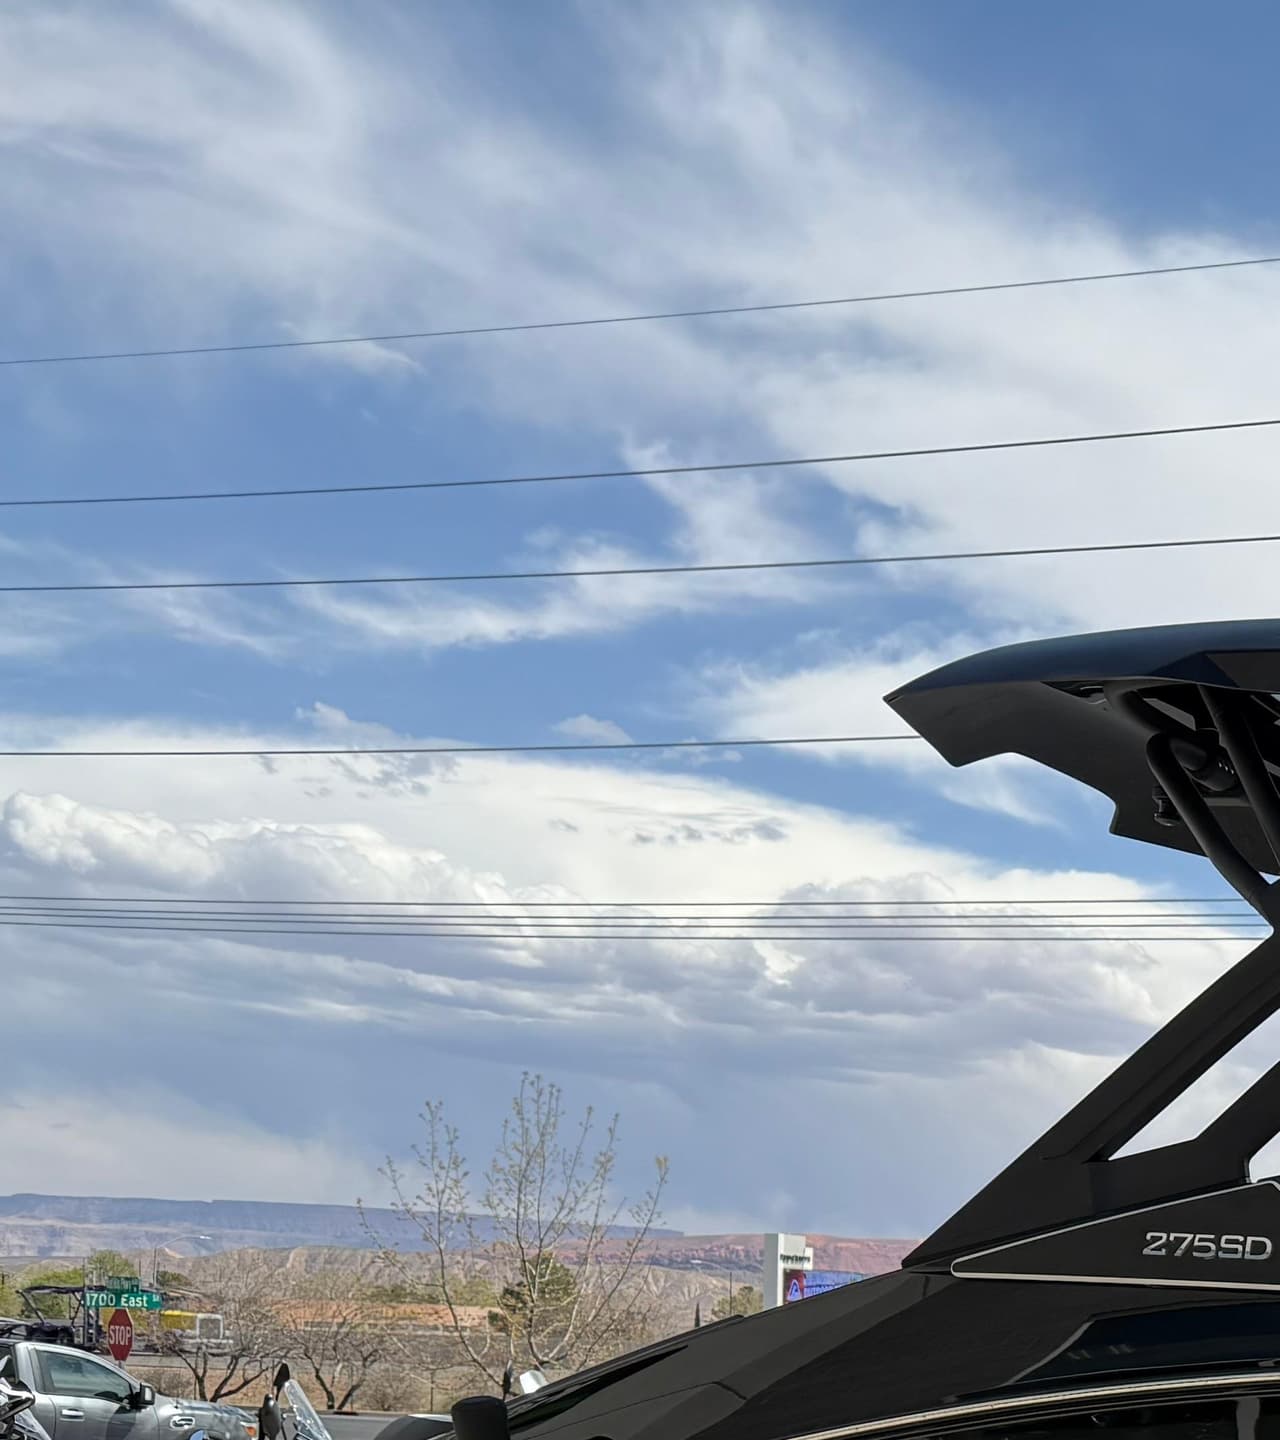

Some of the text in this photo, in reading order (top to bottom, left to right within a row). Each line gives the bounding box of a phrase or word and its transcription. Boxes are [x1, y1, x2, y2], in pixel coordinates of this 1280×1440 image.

[1142, 1231, 1273, 1261] 275SD
[86, 1293, 116, 1307] 1700
[121, 1294, 148, 1307] East
[109, 1325, 132, 1346] STOP
